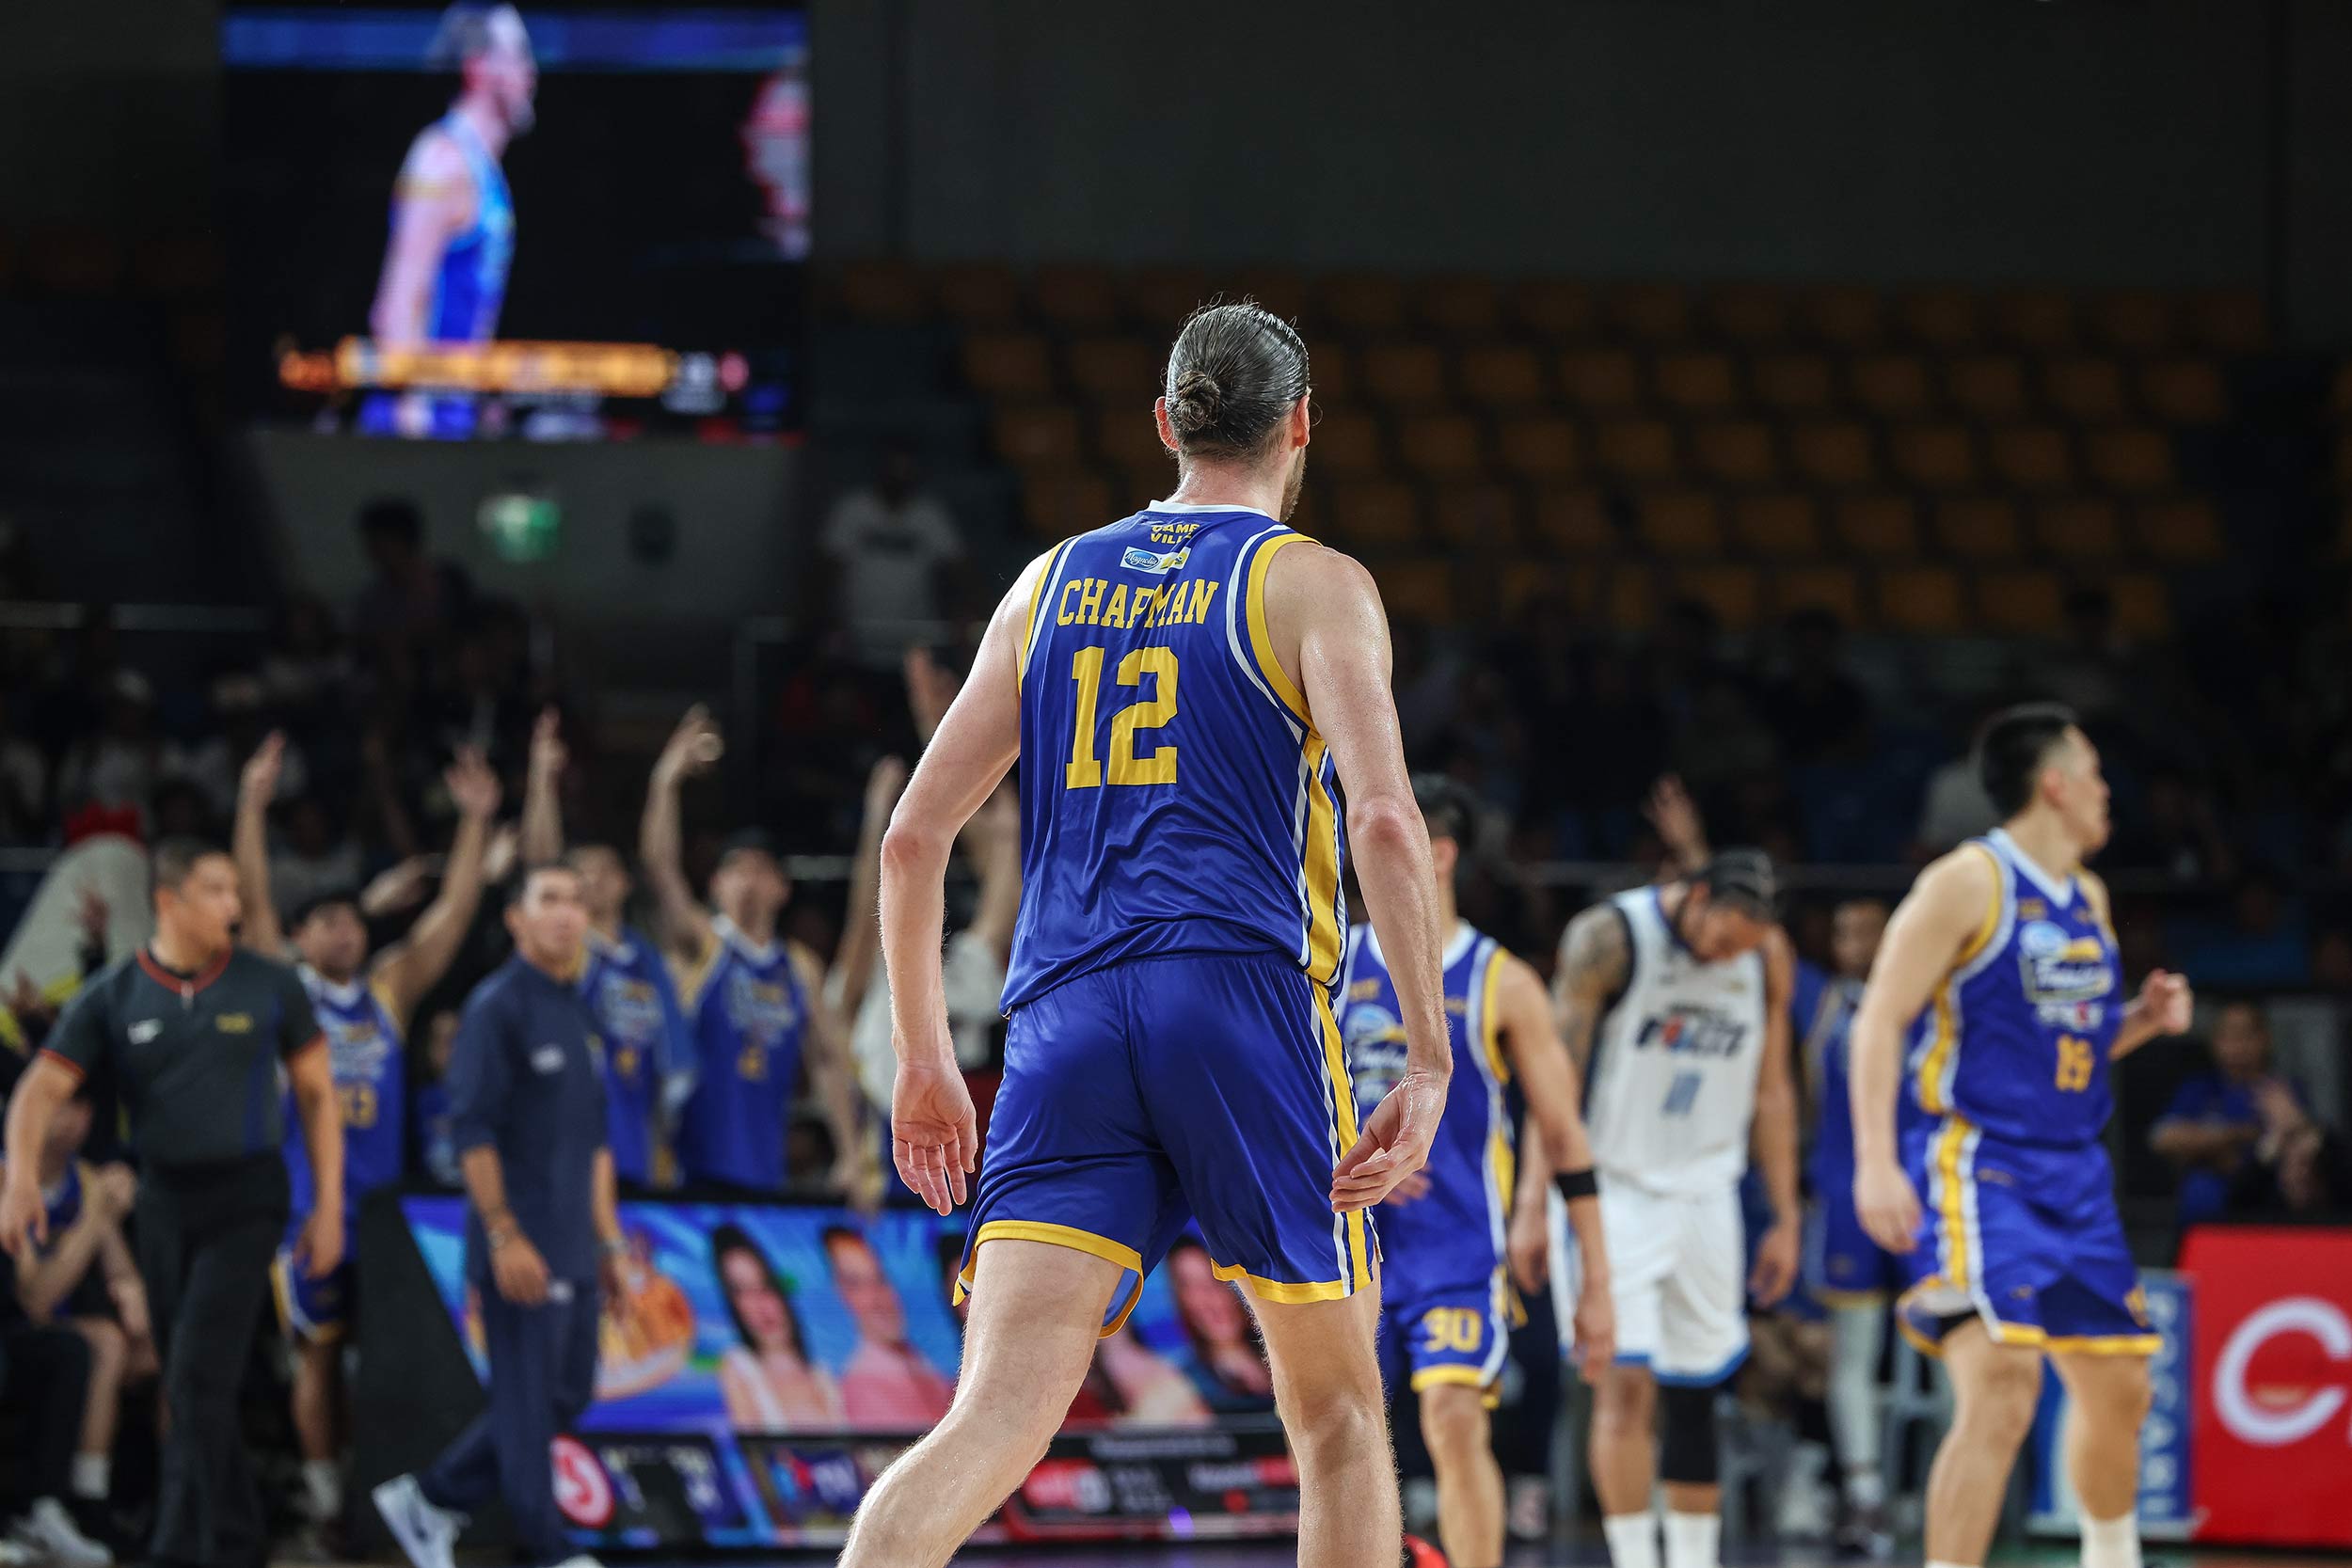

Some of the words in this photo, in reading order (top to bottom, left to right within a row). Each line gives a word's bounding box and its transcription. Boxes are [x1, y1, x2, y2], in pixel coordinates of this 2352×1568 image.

[1125, 551, 1158, 566] Magnolia
[1057, 578, 1219, 629] CHAPMAN
[1066, 645, 1179, 789] 12
[1422, 1306, 1484, 1354] 90
[2213, 1295, 2352, 1447] C
